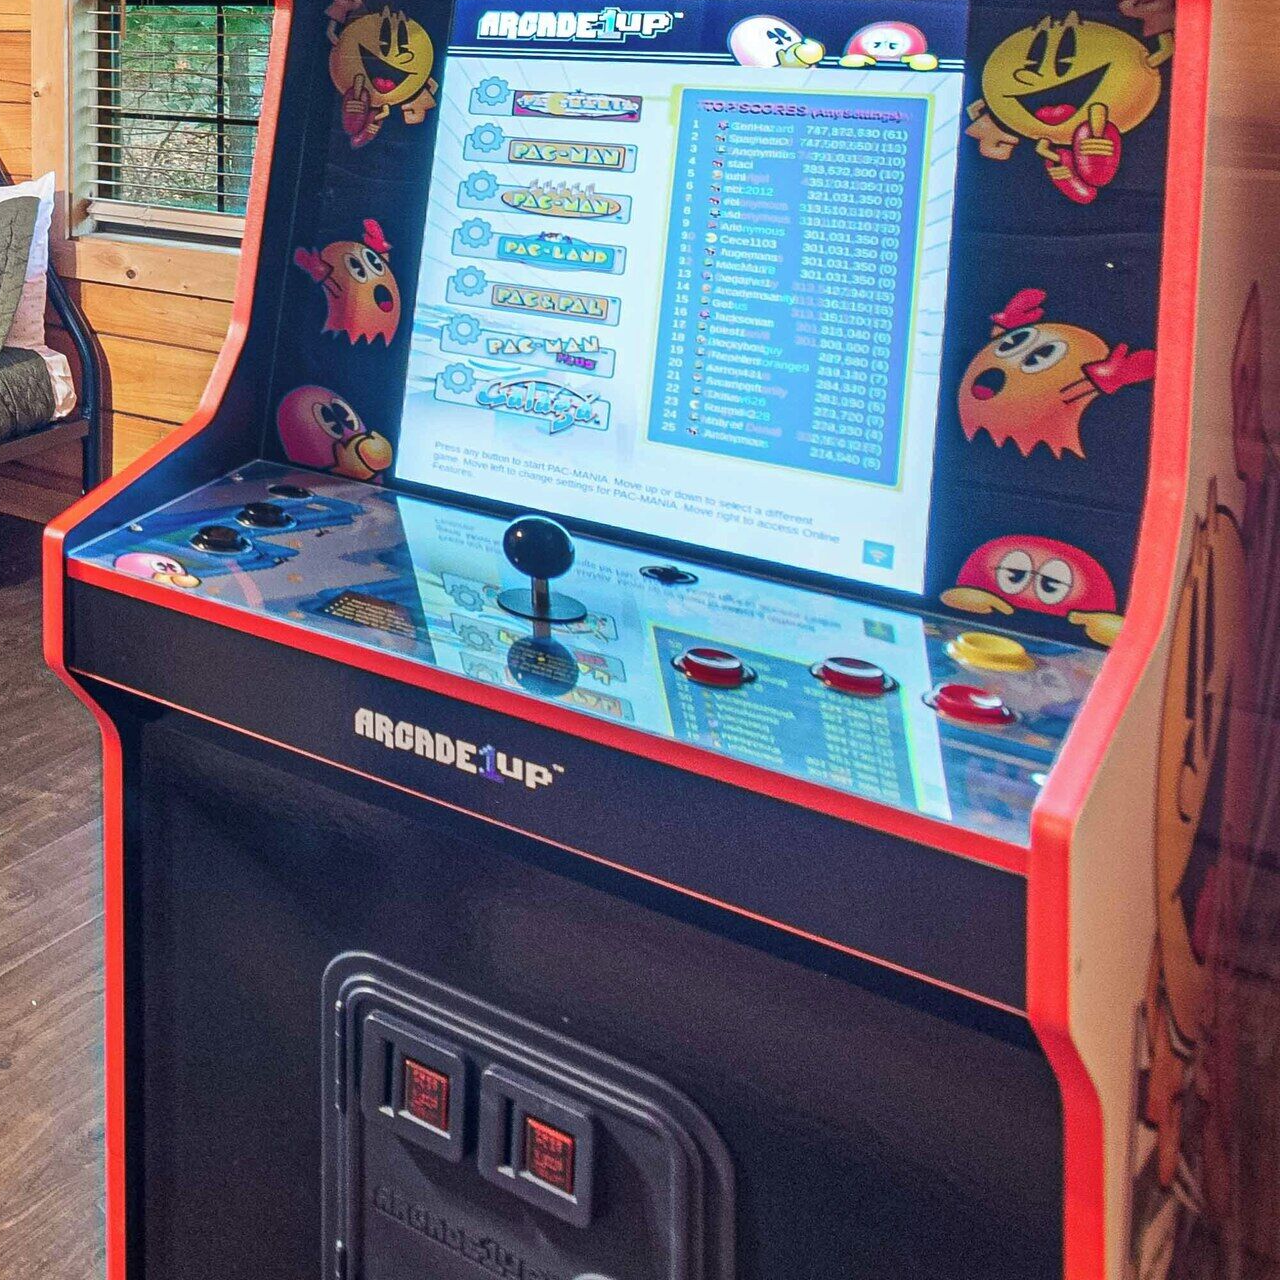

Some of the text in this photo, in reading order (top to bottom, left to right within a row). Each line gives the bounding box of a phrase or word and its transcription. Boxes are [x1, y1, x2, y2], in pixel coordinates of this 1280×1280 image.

[477, 7, 673, 42] ARCADE1UP
[512, 142, 622, 167] PAC-MAN
[504, 241, 608, 264] PAC-LAND
[434, 440, 461, 454] Press
[463, 448, 480, 459] any
[481, 450, 510, 465] button
[524, 459, 546, 471] start
[614, 477, 642, 491] Move
[645, 483, 658, 495] up
[675, 489, 703, 503] down
[718, 500, 752, 514] select
[765, 510, 814, 526] different
[462, 458, 489, 470] Move
[490, 462, 505, 474] left
[518, 469, 553, 484] change
[555, 476, 594, 493] settings
[596, 484, 611, 495] for
[683, 504, 714, 518] Move
[716, 510, 741, 524] right
[757, 520, 800, 535] access
[802, 528, 841, 544] Online
[354, 707, 554, 789] ARCADE1UP
